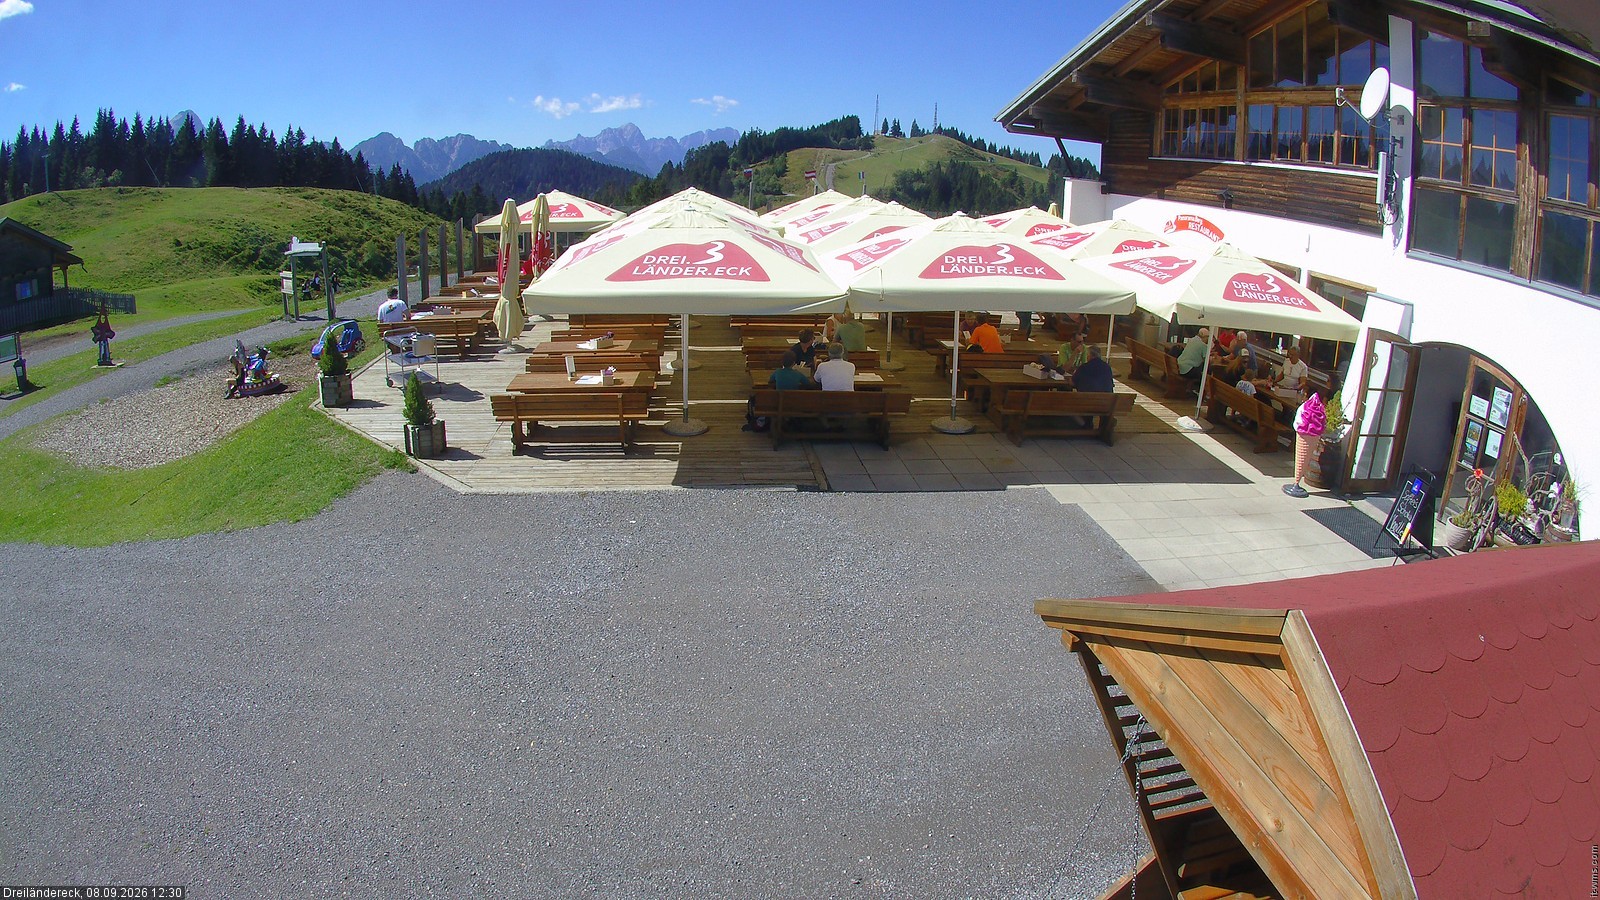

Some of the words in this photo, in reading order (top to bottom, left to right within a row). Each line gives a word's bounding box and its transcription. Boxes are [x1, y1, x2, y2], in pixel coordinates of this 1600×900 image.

[1187, 221, 1221, 243] RESTAURANT
[643, 255, 691, 265] DREI.
[944, 255, 989, 265] DREI.
[631, 264, 753, 277] LÄNDER.ECK
[940, 264, 1046, 276] LÄNDER.ECK
[1231, 280, 1265, 293] DREI.
[1233, 288, 1307, 307] LÄNDER.ECK
